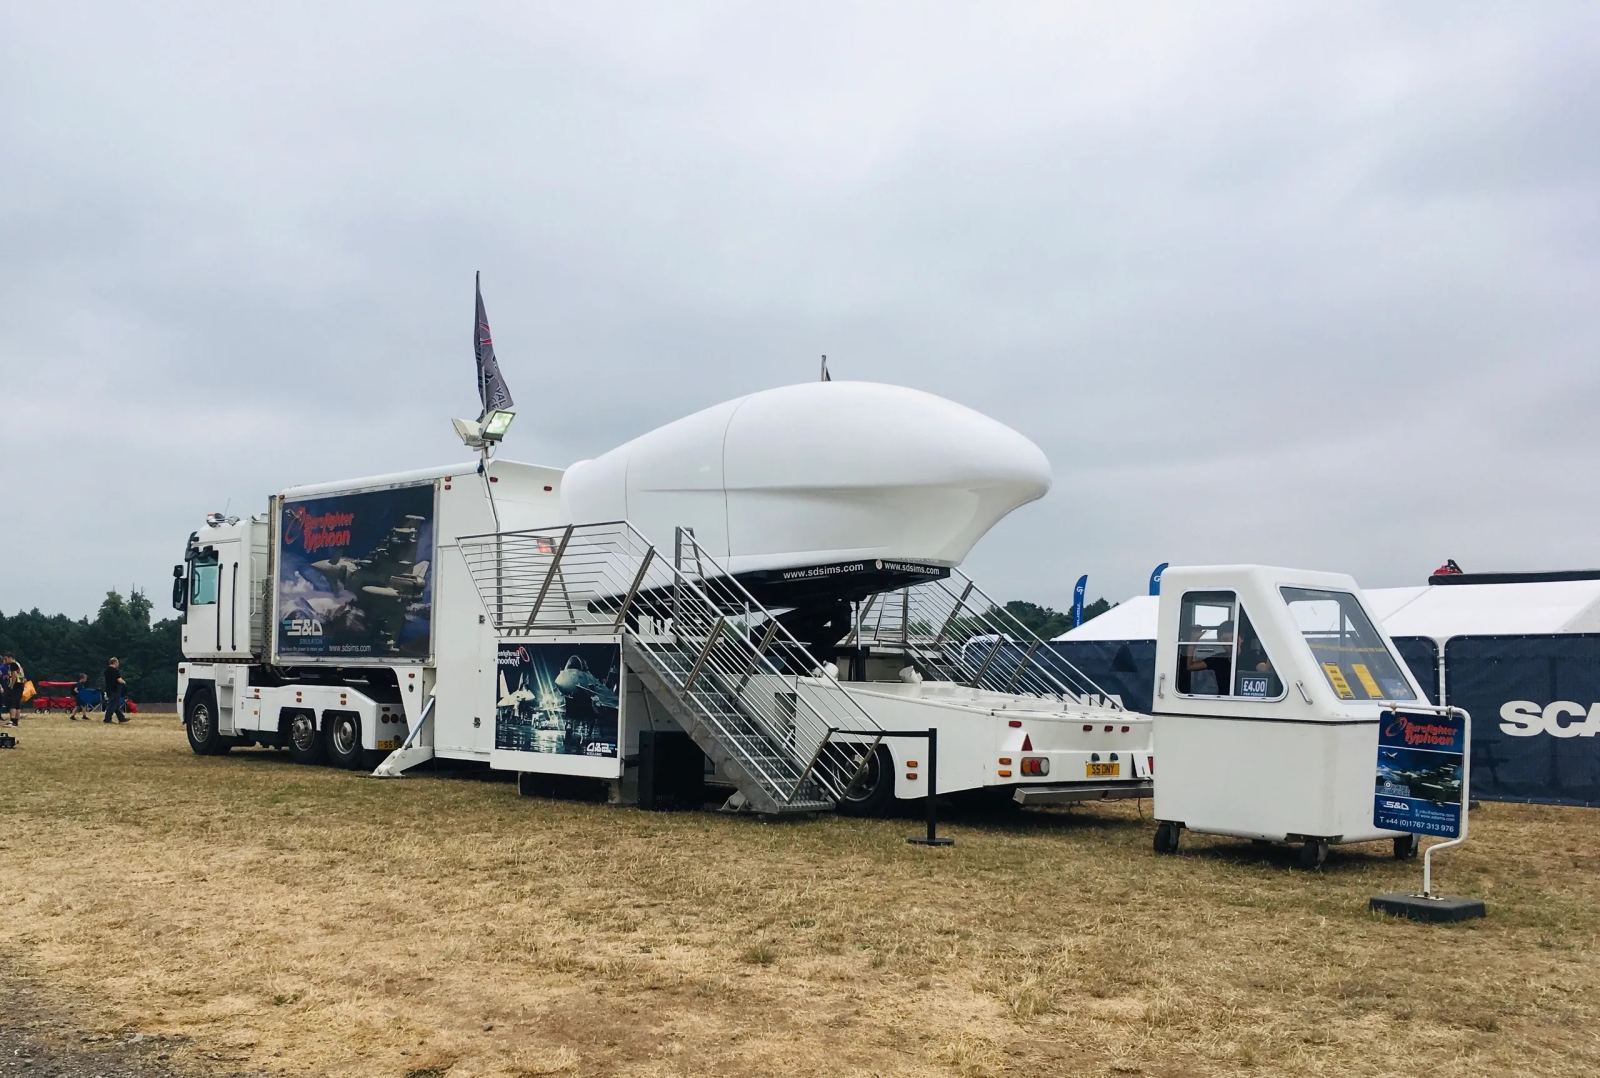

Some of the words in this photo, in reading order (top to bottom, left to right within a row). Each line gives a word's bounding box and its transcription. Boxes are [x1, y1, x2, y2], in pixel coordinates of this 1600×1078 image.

[303, 527, 351, 553] Typhoon
[783, 562, 864, 580] www.sdsims.com
[884, 562, 940, 576] www.sdsims.com
[286, 619, 323, 636] S&D
[329, 644, 372, 653] www.sdsims.com
[1243, 680, 1265, 692] £4.00
[1405, 729, 1454, 745] Typhoon
[1383, 801, 1410, 810] S&D
[1426, 823, 1440, 831] 313
